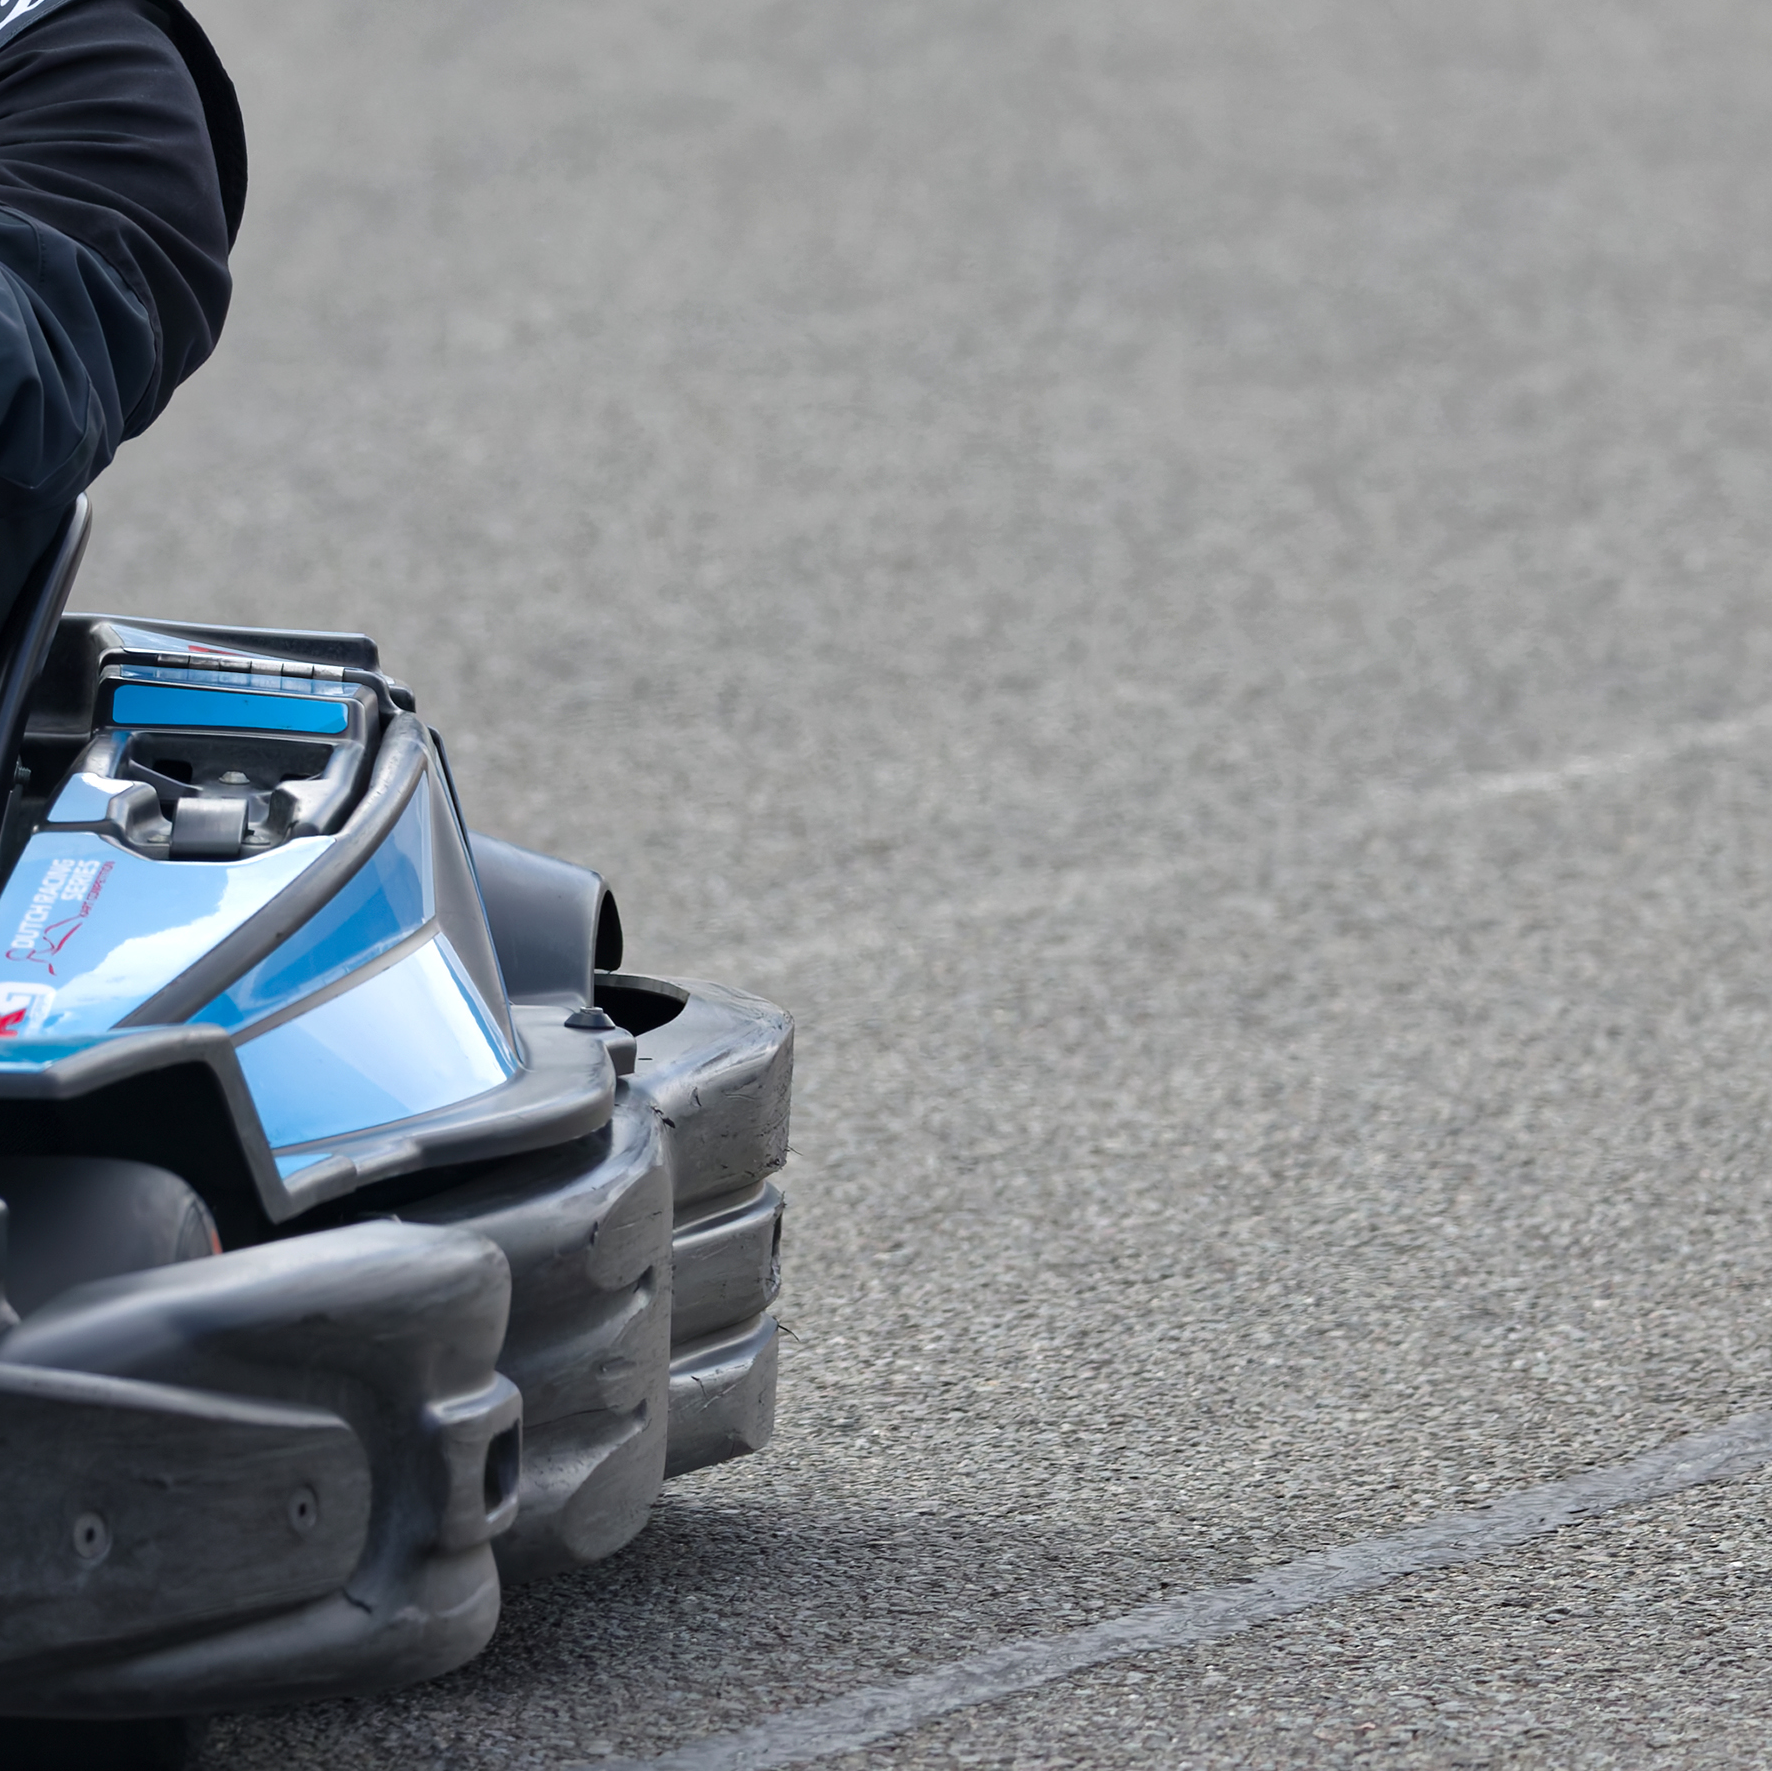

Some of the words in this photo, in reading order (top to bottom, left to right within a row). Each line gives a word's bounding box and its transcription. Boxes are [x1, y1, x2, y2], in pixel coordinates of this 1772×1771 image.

[10, 904, 52, 949] DUTCH
[33, 859, 75, 904] RACING
[60, 859, 100, 901] SERIES
